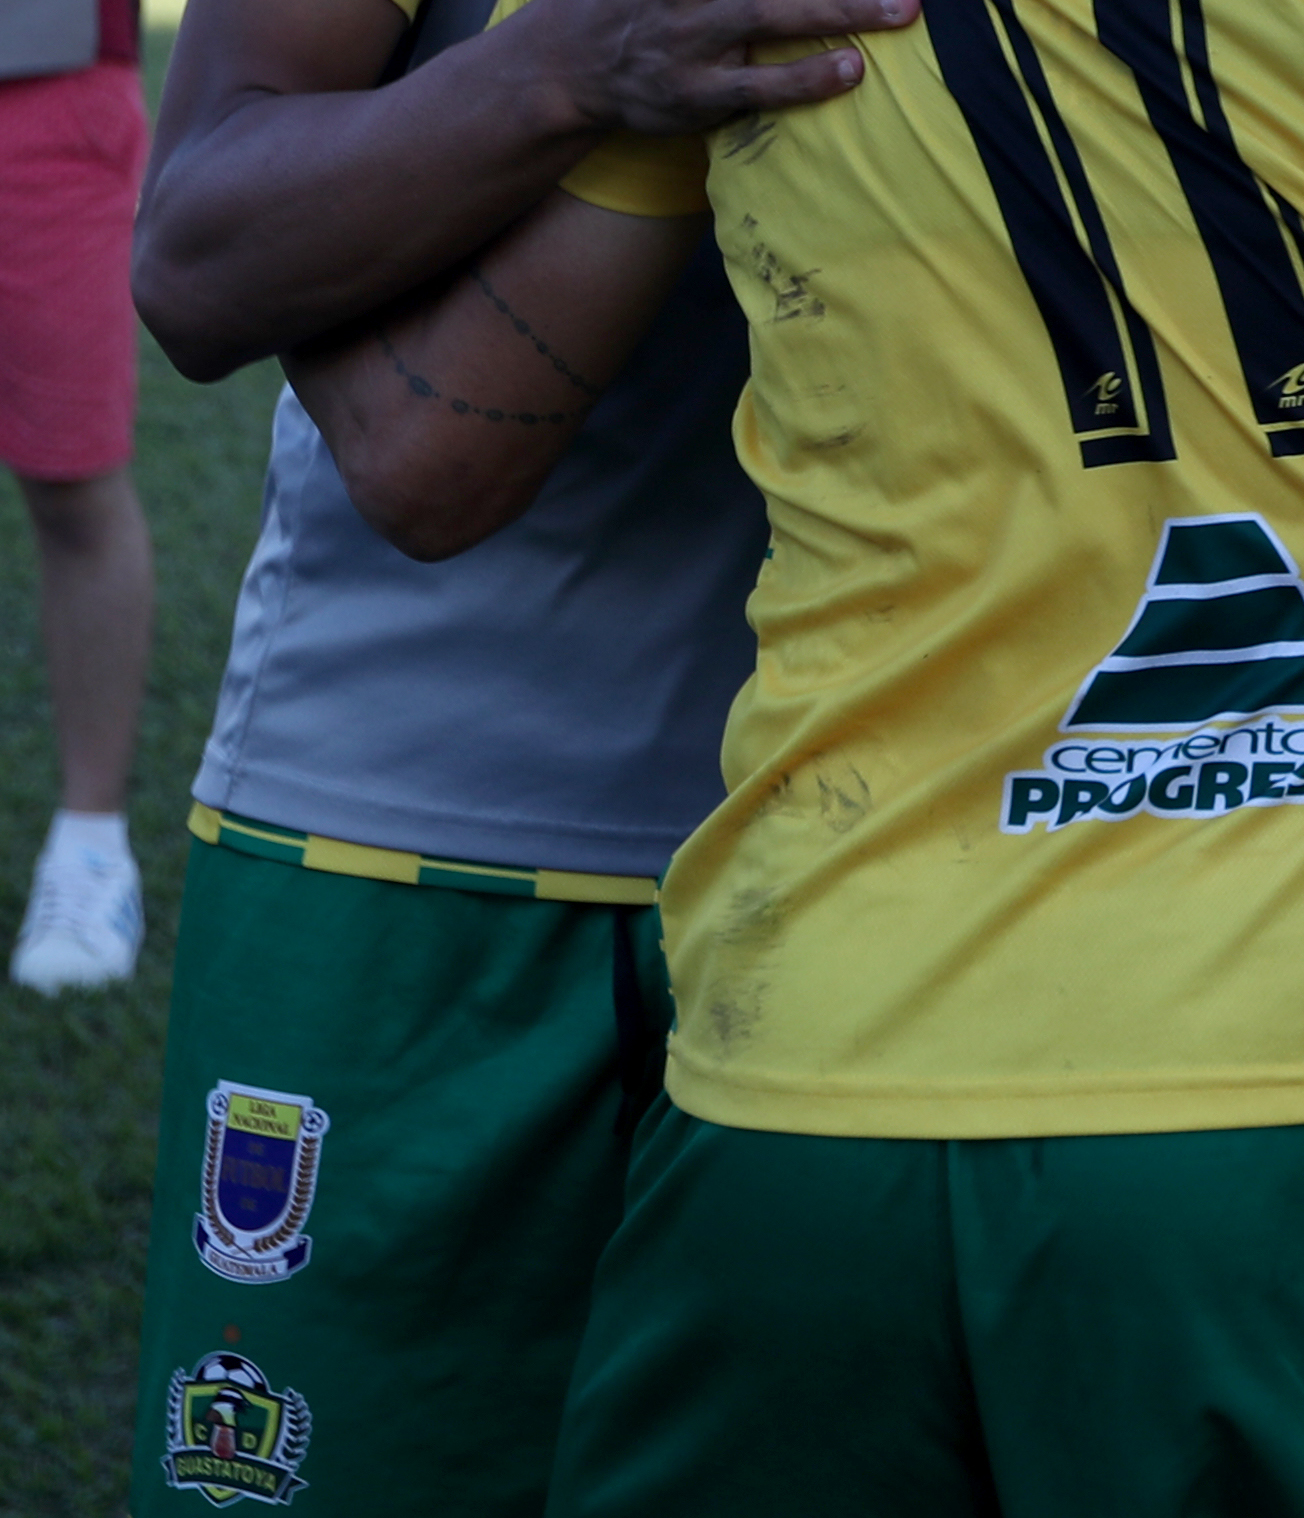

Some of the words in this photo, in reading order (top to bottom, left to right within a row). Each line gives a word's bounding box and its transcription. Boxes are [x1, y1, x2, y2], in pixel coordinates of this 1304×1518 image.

[193, 1422, 209, 1441] C
[241, 1431, 258, 1450] D
[176, 1454, 278, 1493] GUASTATOYA
